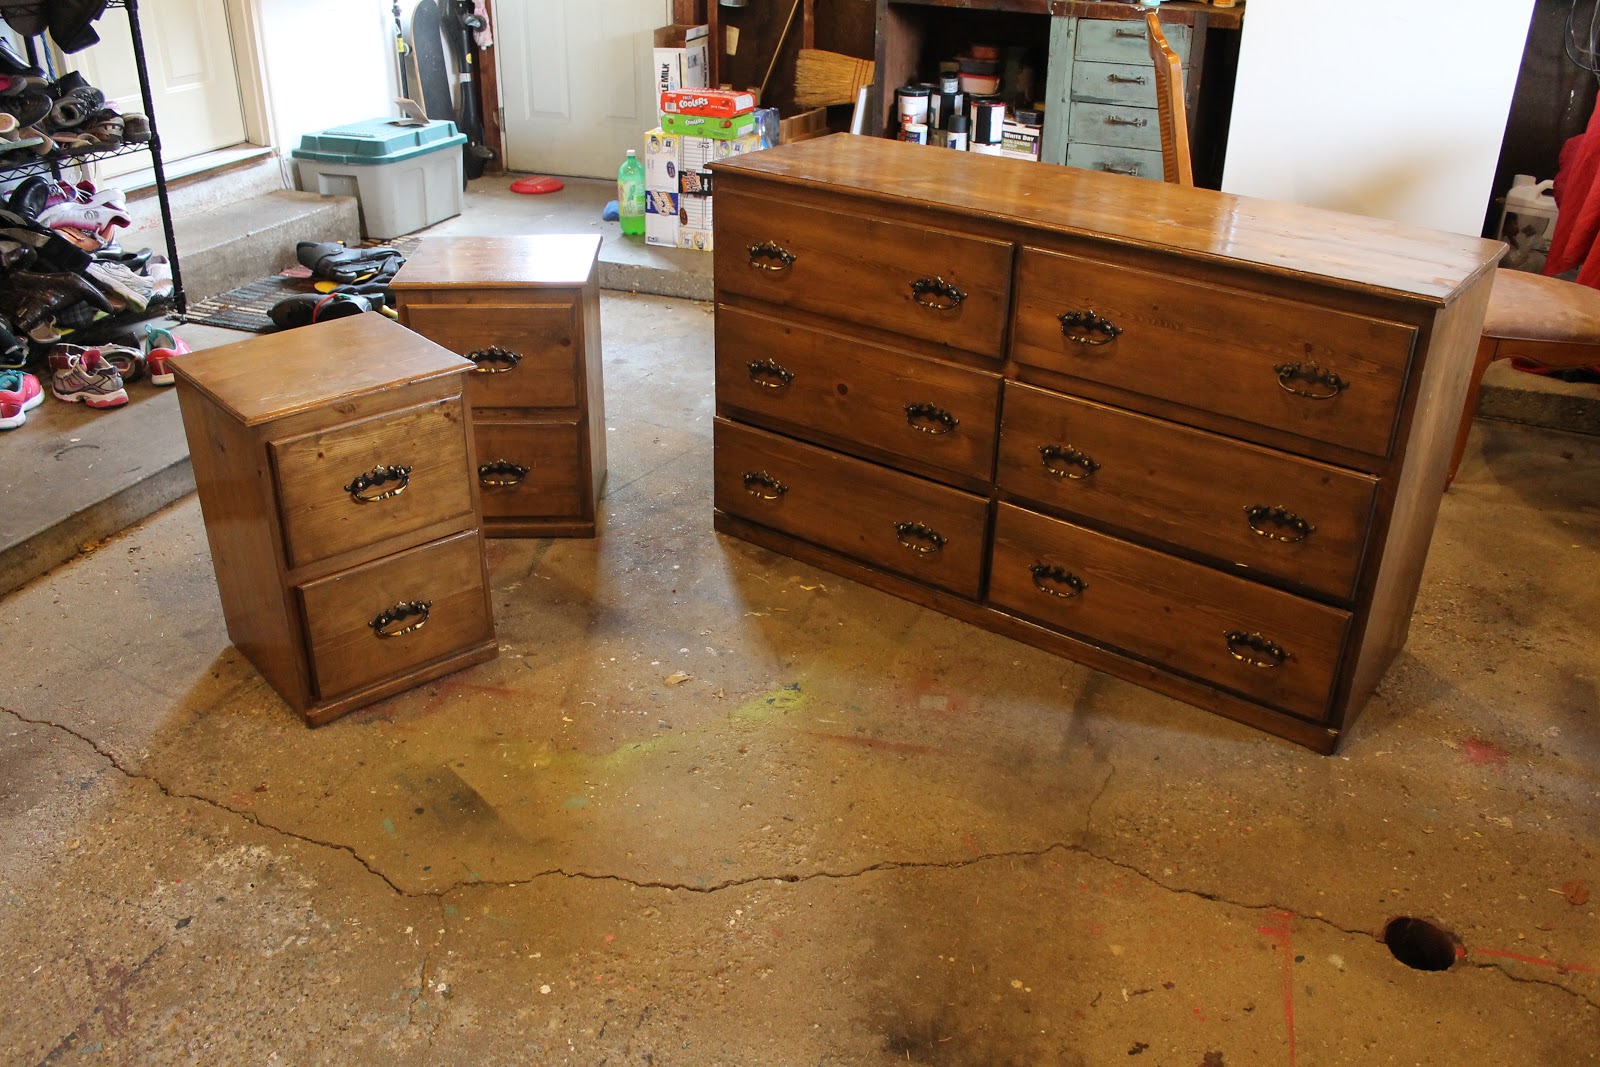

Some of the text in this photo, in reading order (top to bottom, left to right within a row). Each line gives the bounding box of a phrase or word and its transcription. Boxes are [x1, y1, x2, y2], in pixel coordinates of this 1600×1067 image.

[661, 63, 670, 92] LE MILK
[679, 98, 709, 108] COOLERS
[1004, 132, 1022, 140] WHITE
